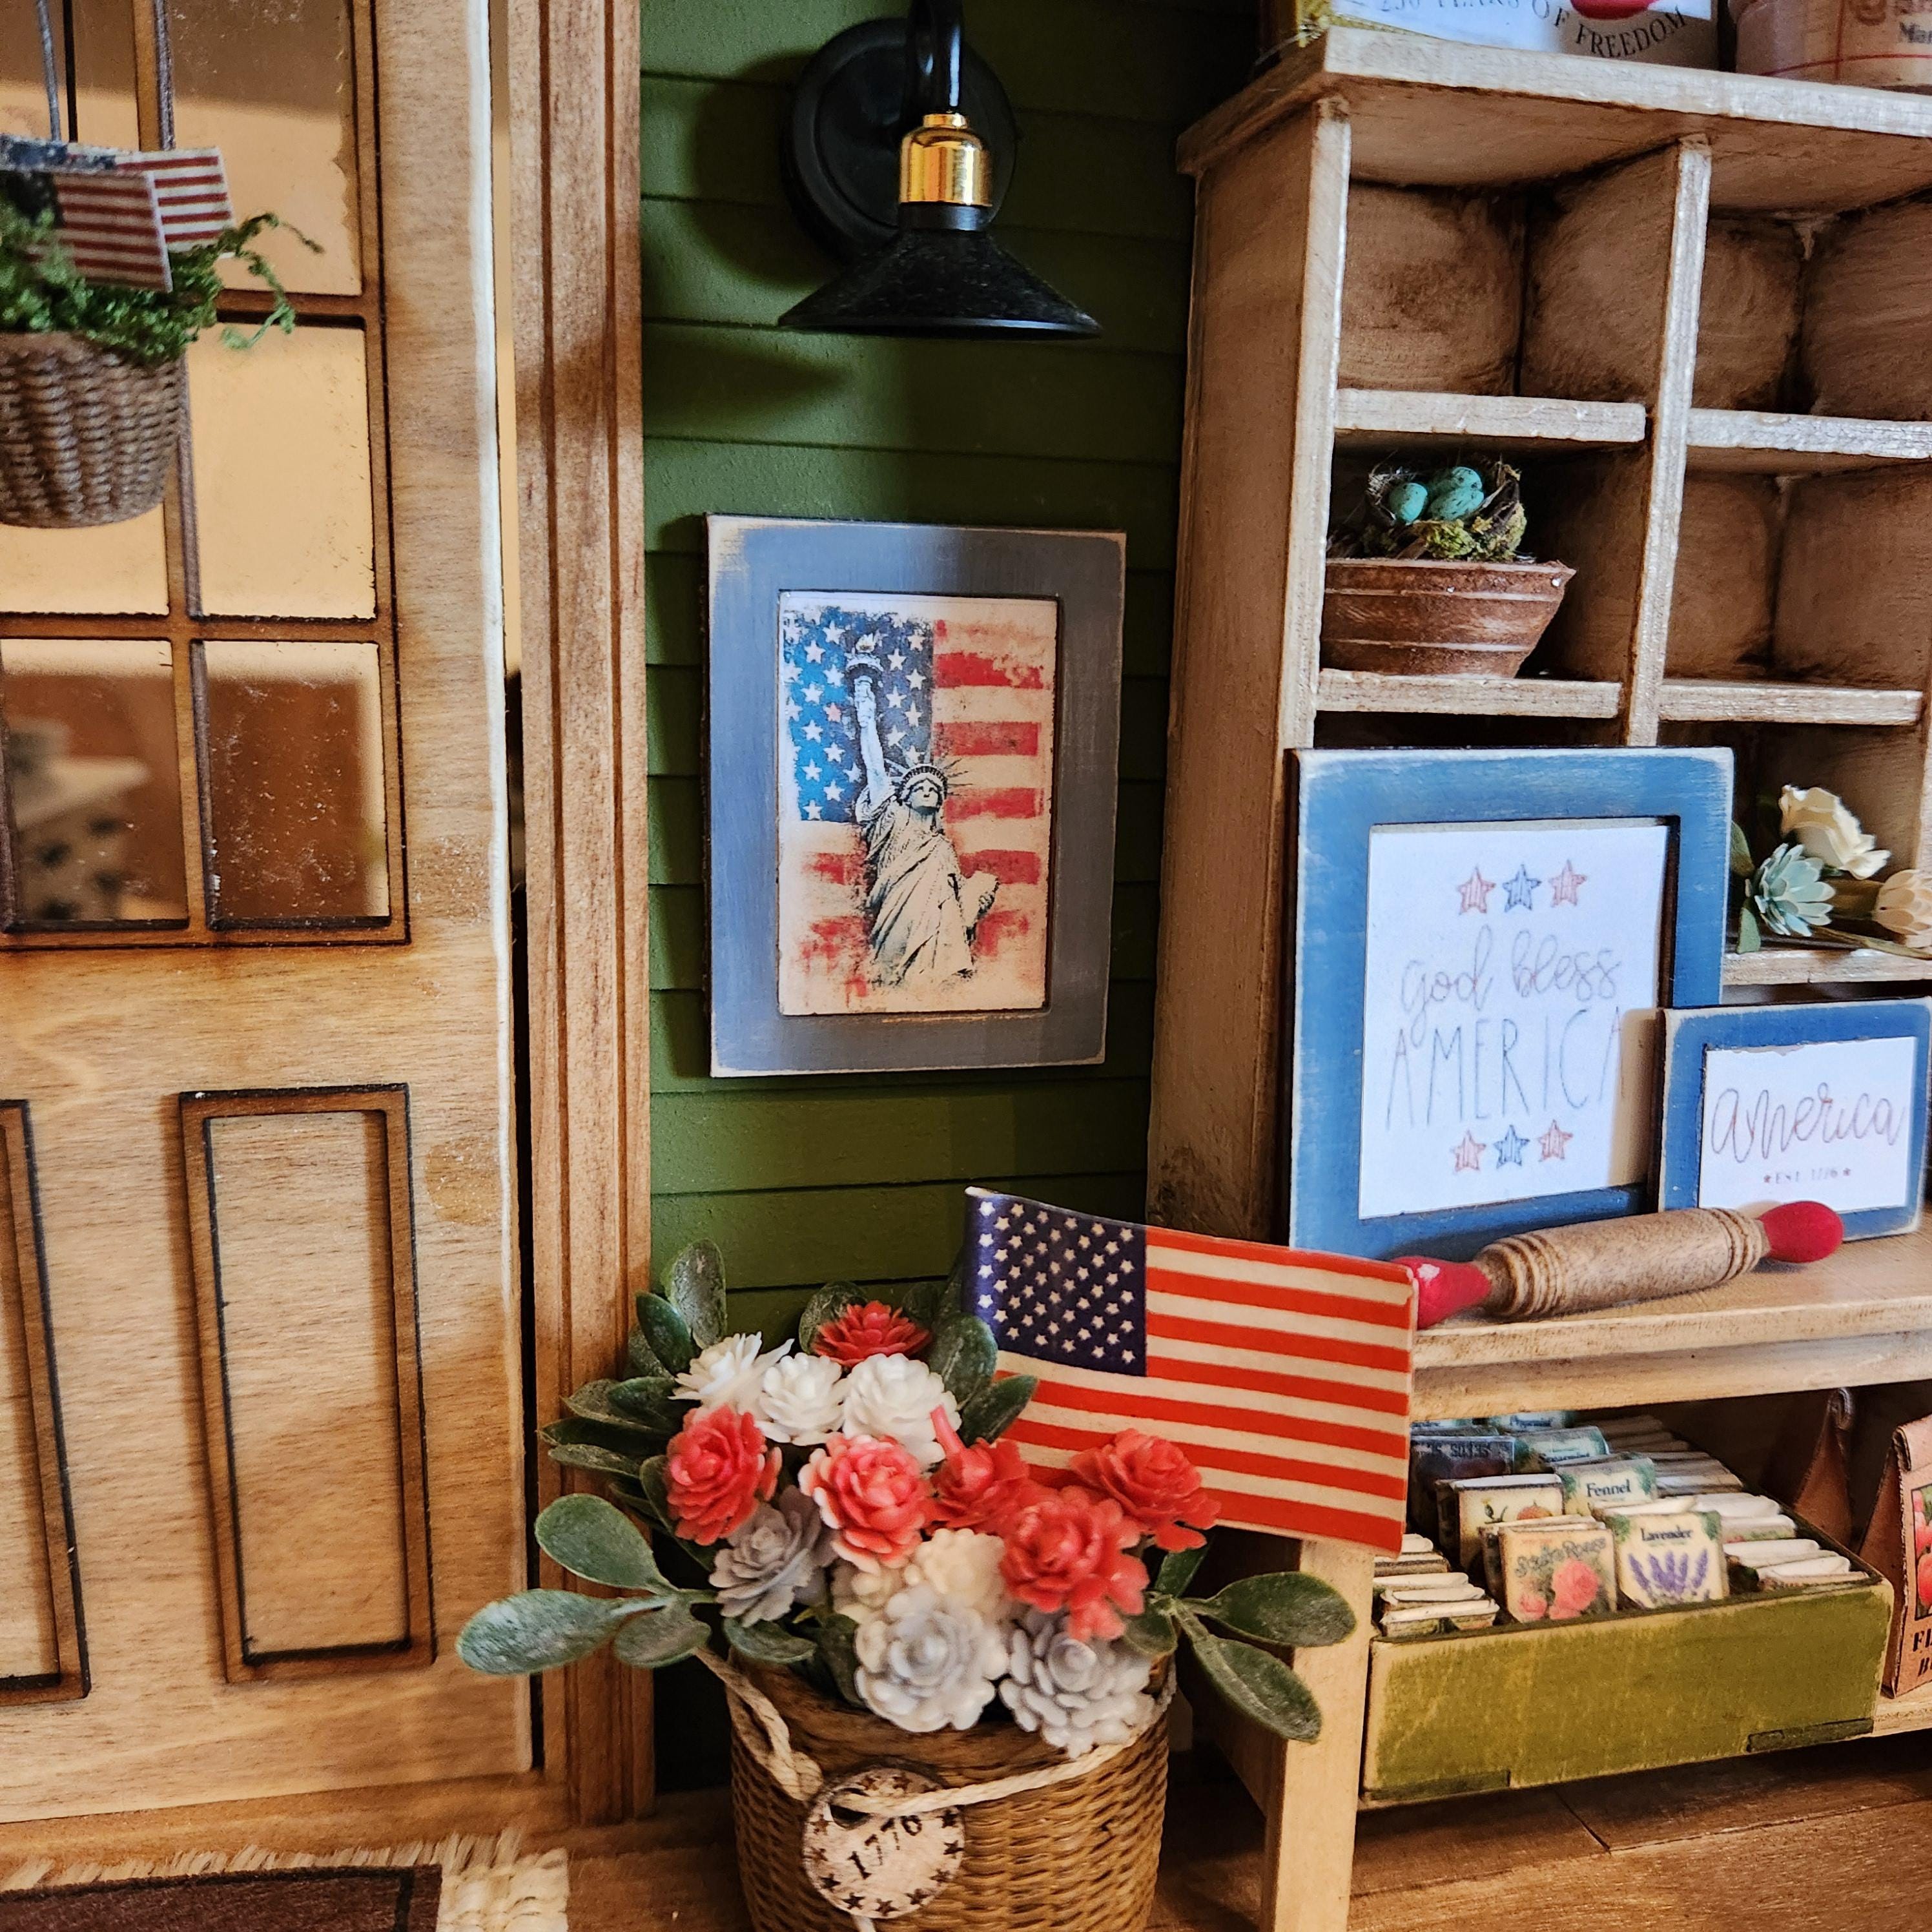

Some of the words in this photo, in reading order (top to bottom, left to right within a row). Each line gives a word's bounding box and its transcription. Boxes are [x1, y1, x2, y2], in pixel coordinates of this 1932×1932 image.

[1532, 0, 1570, 26] OF
[1575, 5, 1686, 59] FREEDOM
[1511, 929, 1621, 1002] bless
[1386, 1005, 1625, 1131] AMERICA
[1586, 1479, 1632, 1497] Fennel
[1640, 1525, 1694, 1542] Lavender
